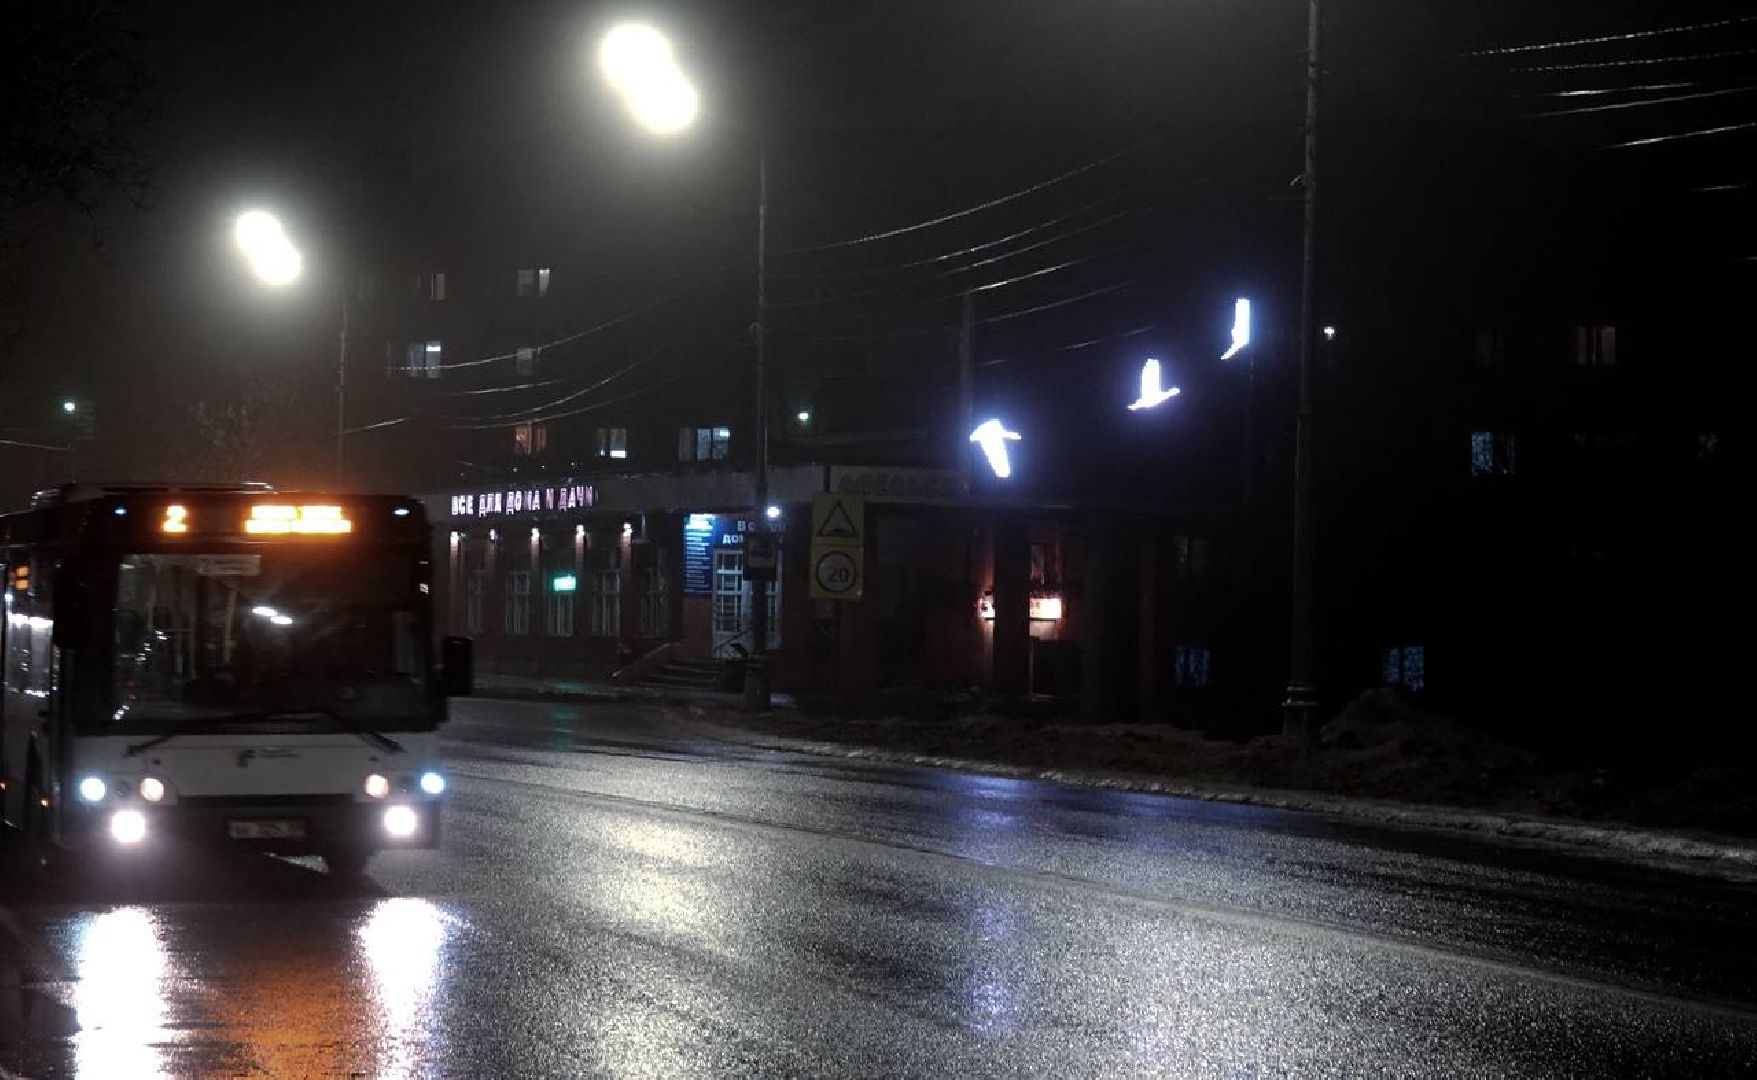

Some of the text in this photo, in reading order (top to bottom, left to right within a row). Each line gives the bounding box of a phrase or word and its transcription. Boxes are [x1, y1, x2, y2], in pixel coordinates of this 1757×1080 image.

[451, 494, 474, 515] ВСЕ
[506, 489, 540, 515] ДОМА
[559, 485, 594, 512] ДАЧИ
[162, 505, 187, 532] 2
[828, 566, 850, 583] 20
